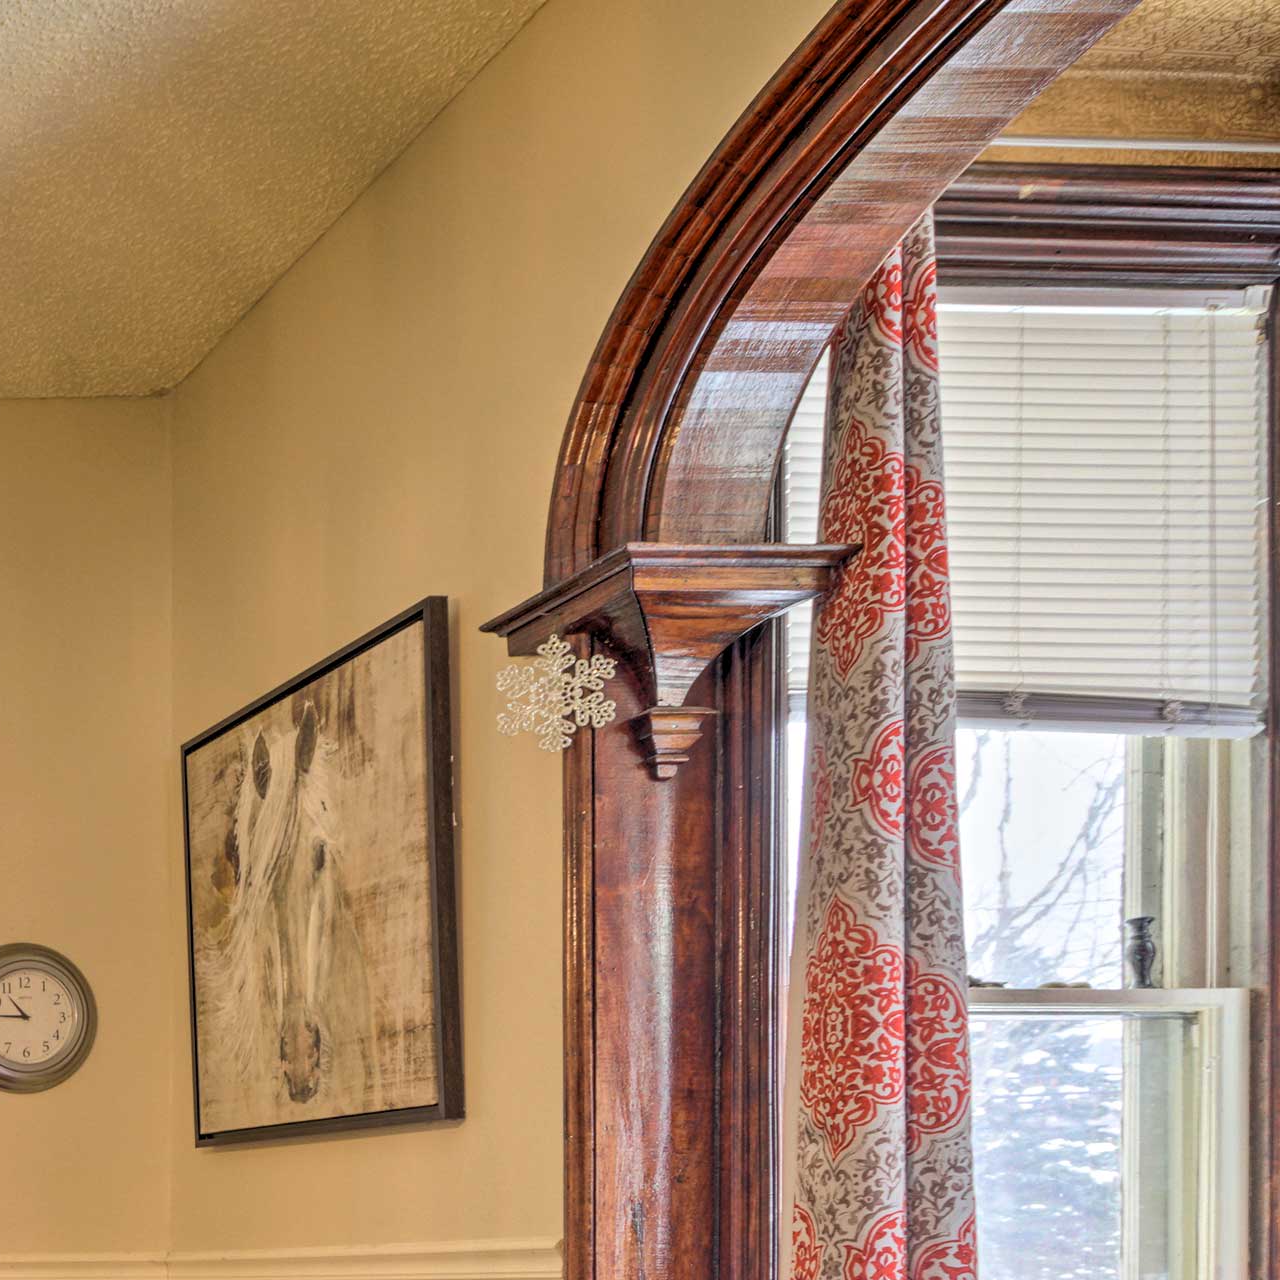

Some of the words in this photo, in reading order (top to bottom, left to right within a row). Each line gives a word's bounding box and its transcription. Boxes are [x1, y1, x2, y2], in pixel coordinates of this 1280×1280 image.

[1, 982, 12, 994] 11
[18, 976, 31, 989] 12
[41, 980, 46, 992] 1
[53, 993, 61, 1006] 2
[59, 1011, 66, 1024] 3
[52, 1029, 60, 1041] 4
[4, 1042, 12, 1054] 7
[22, 1046, 31, 1058] 6
[42, 1041, 50, 1053] 5
